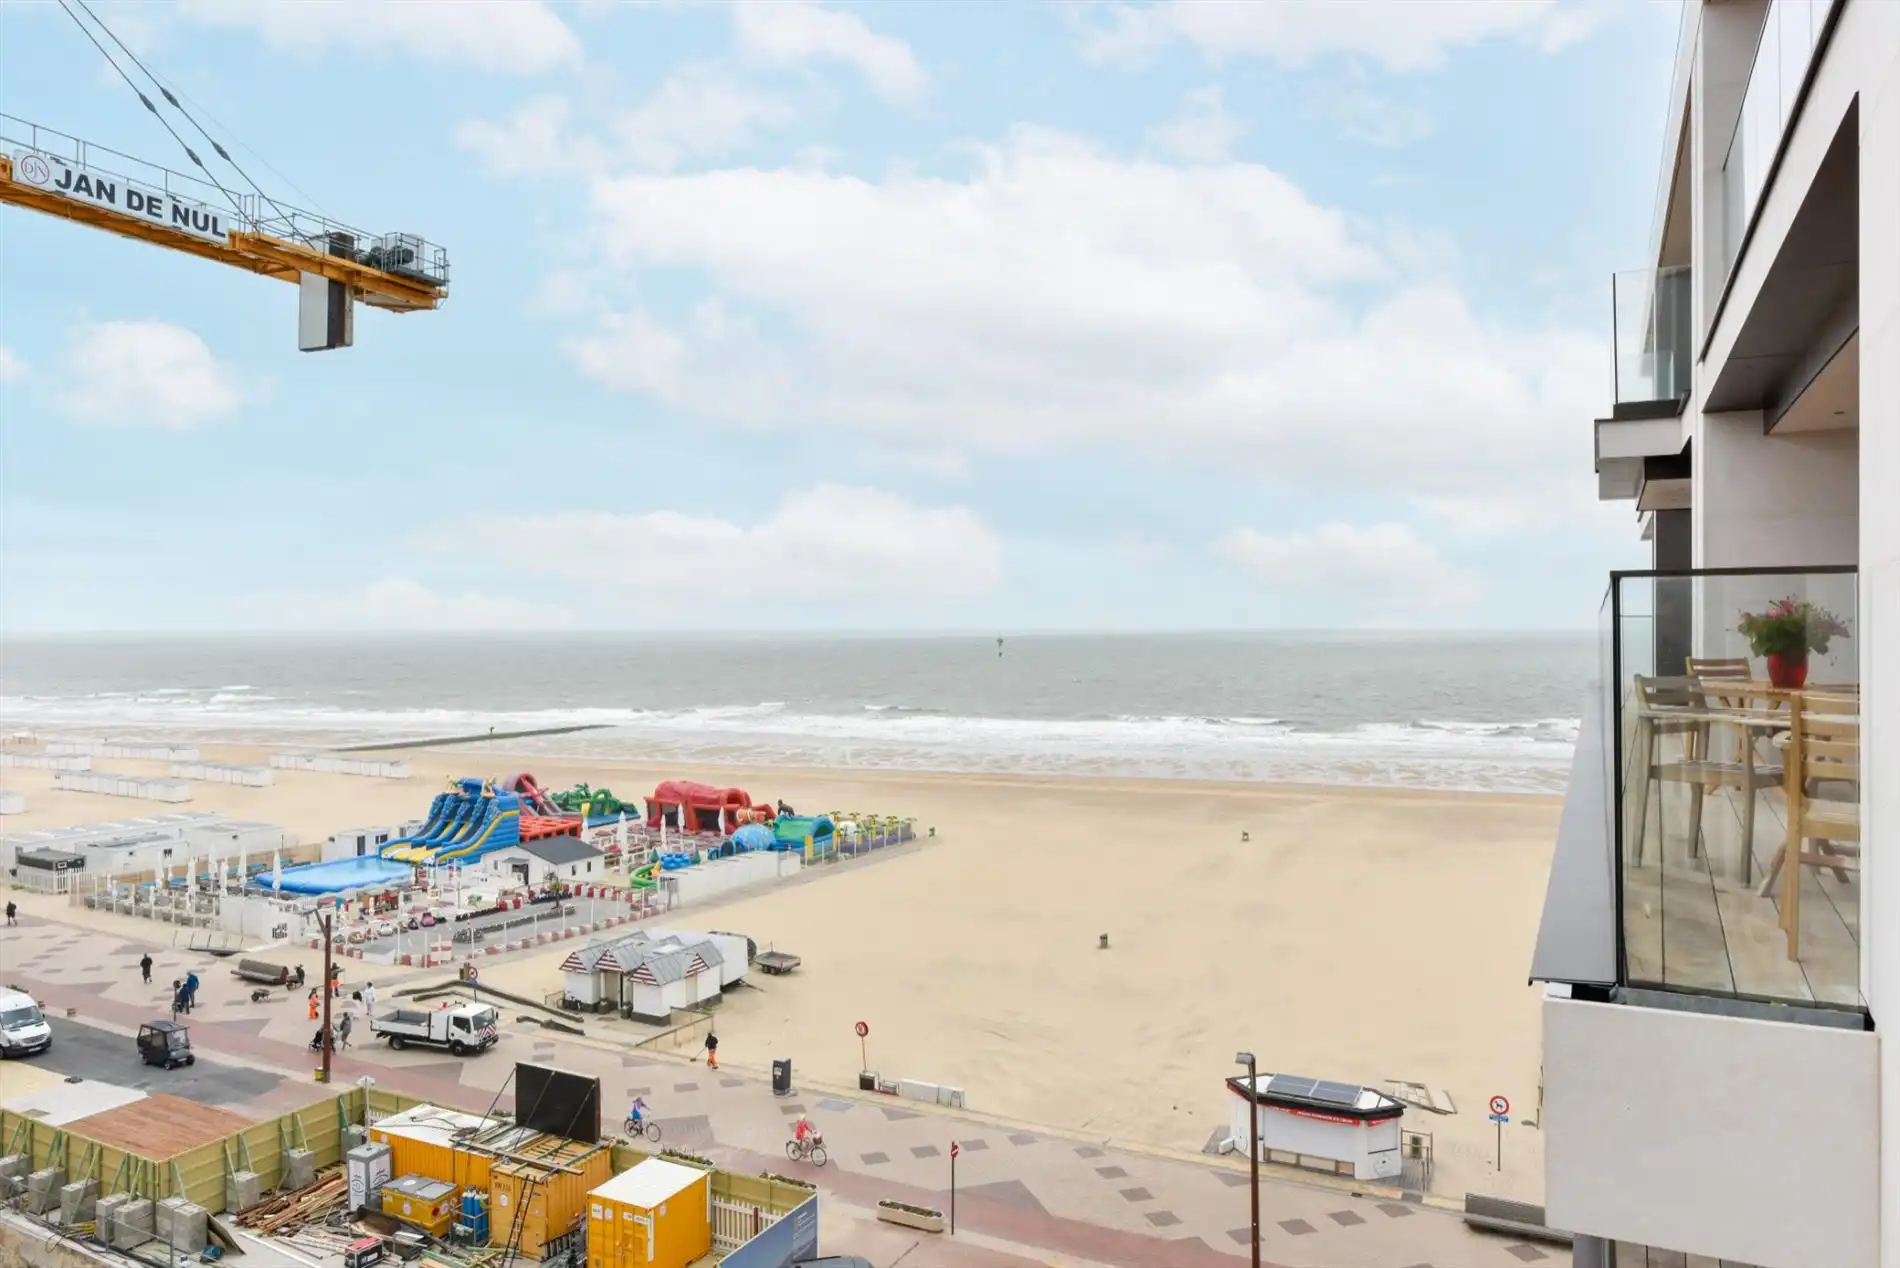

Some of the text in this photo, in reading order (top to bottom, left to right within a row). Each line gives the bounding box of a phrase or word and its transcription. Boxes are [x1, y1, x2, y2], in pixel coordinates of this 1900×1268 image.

[54, 169, 226, 239] JAN DE NUL
